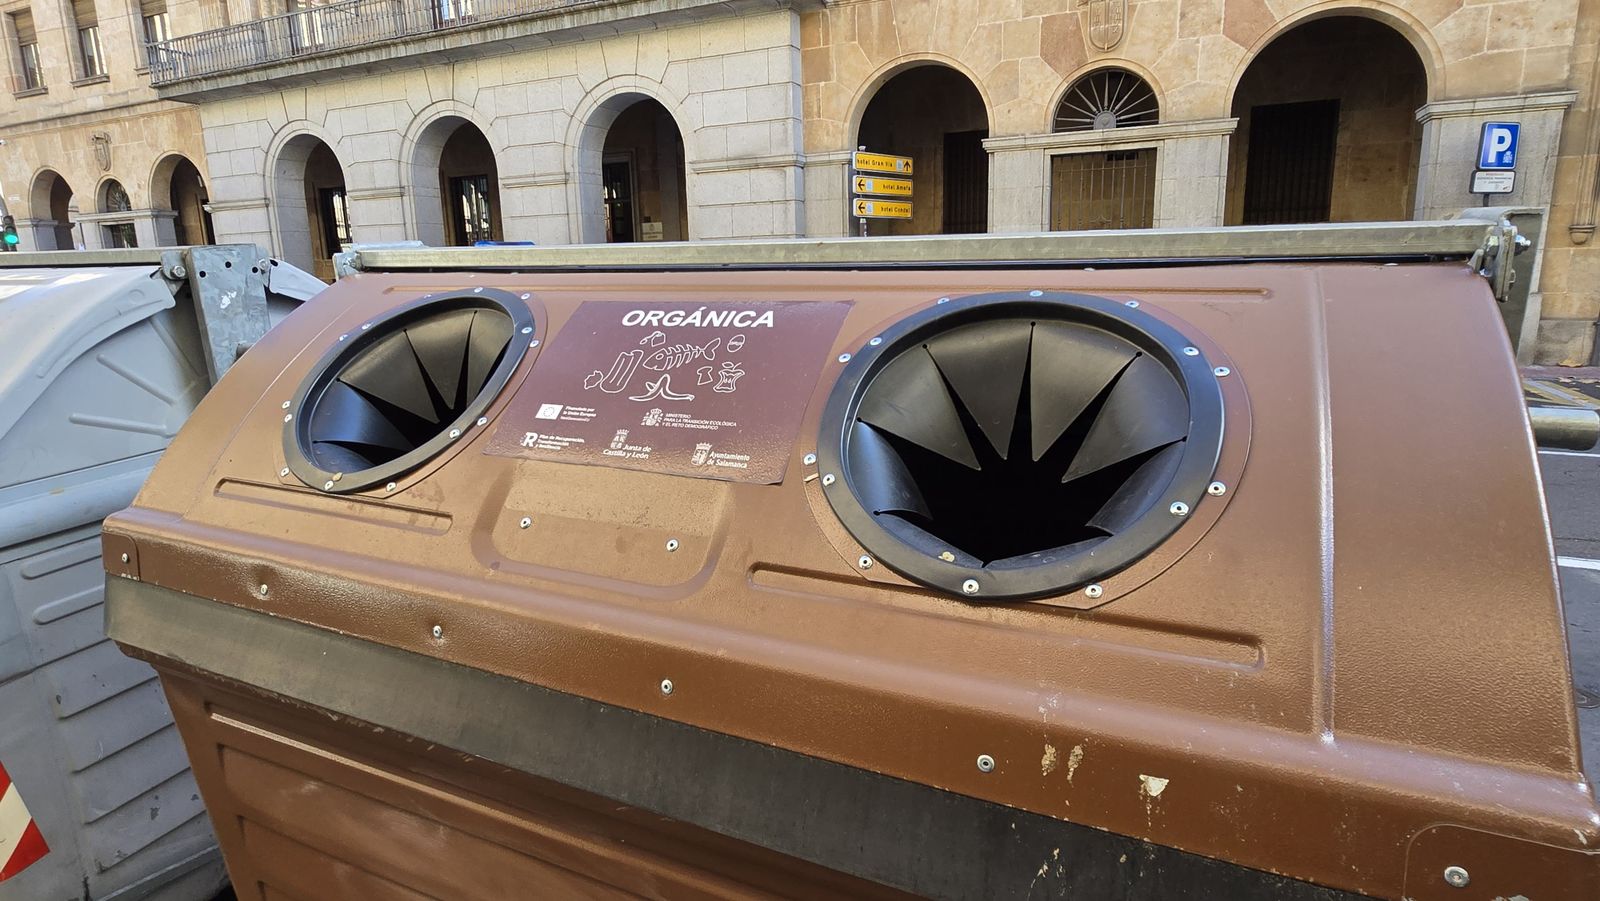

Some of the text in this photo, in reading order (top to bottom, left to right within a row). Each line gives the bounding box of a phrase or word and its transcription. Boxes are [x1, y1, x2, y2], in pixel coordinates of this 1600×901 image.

[1487, 128, 1512, 163] P
[622, 306, 774, 328] ORGÁNICA
[709, 451, 750, 461] Ayuntamiento
[716, 460, 748, 469] Salamanca
